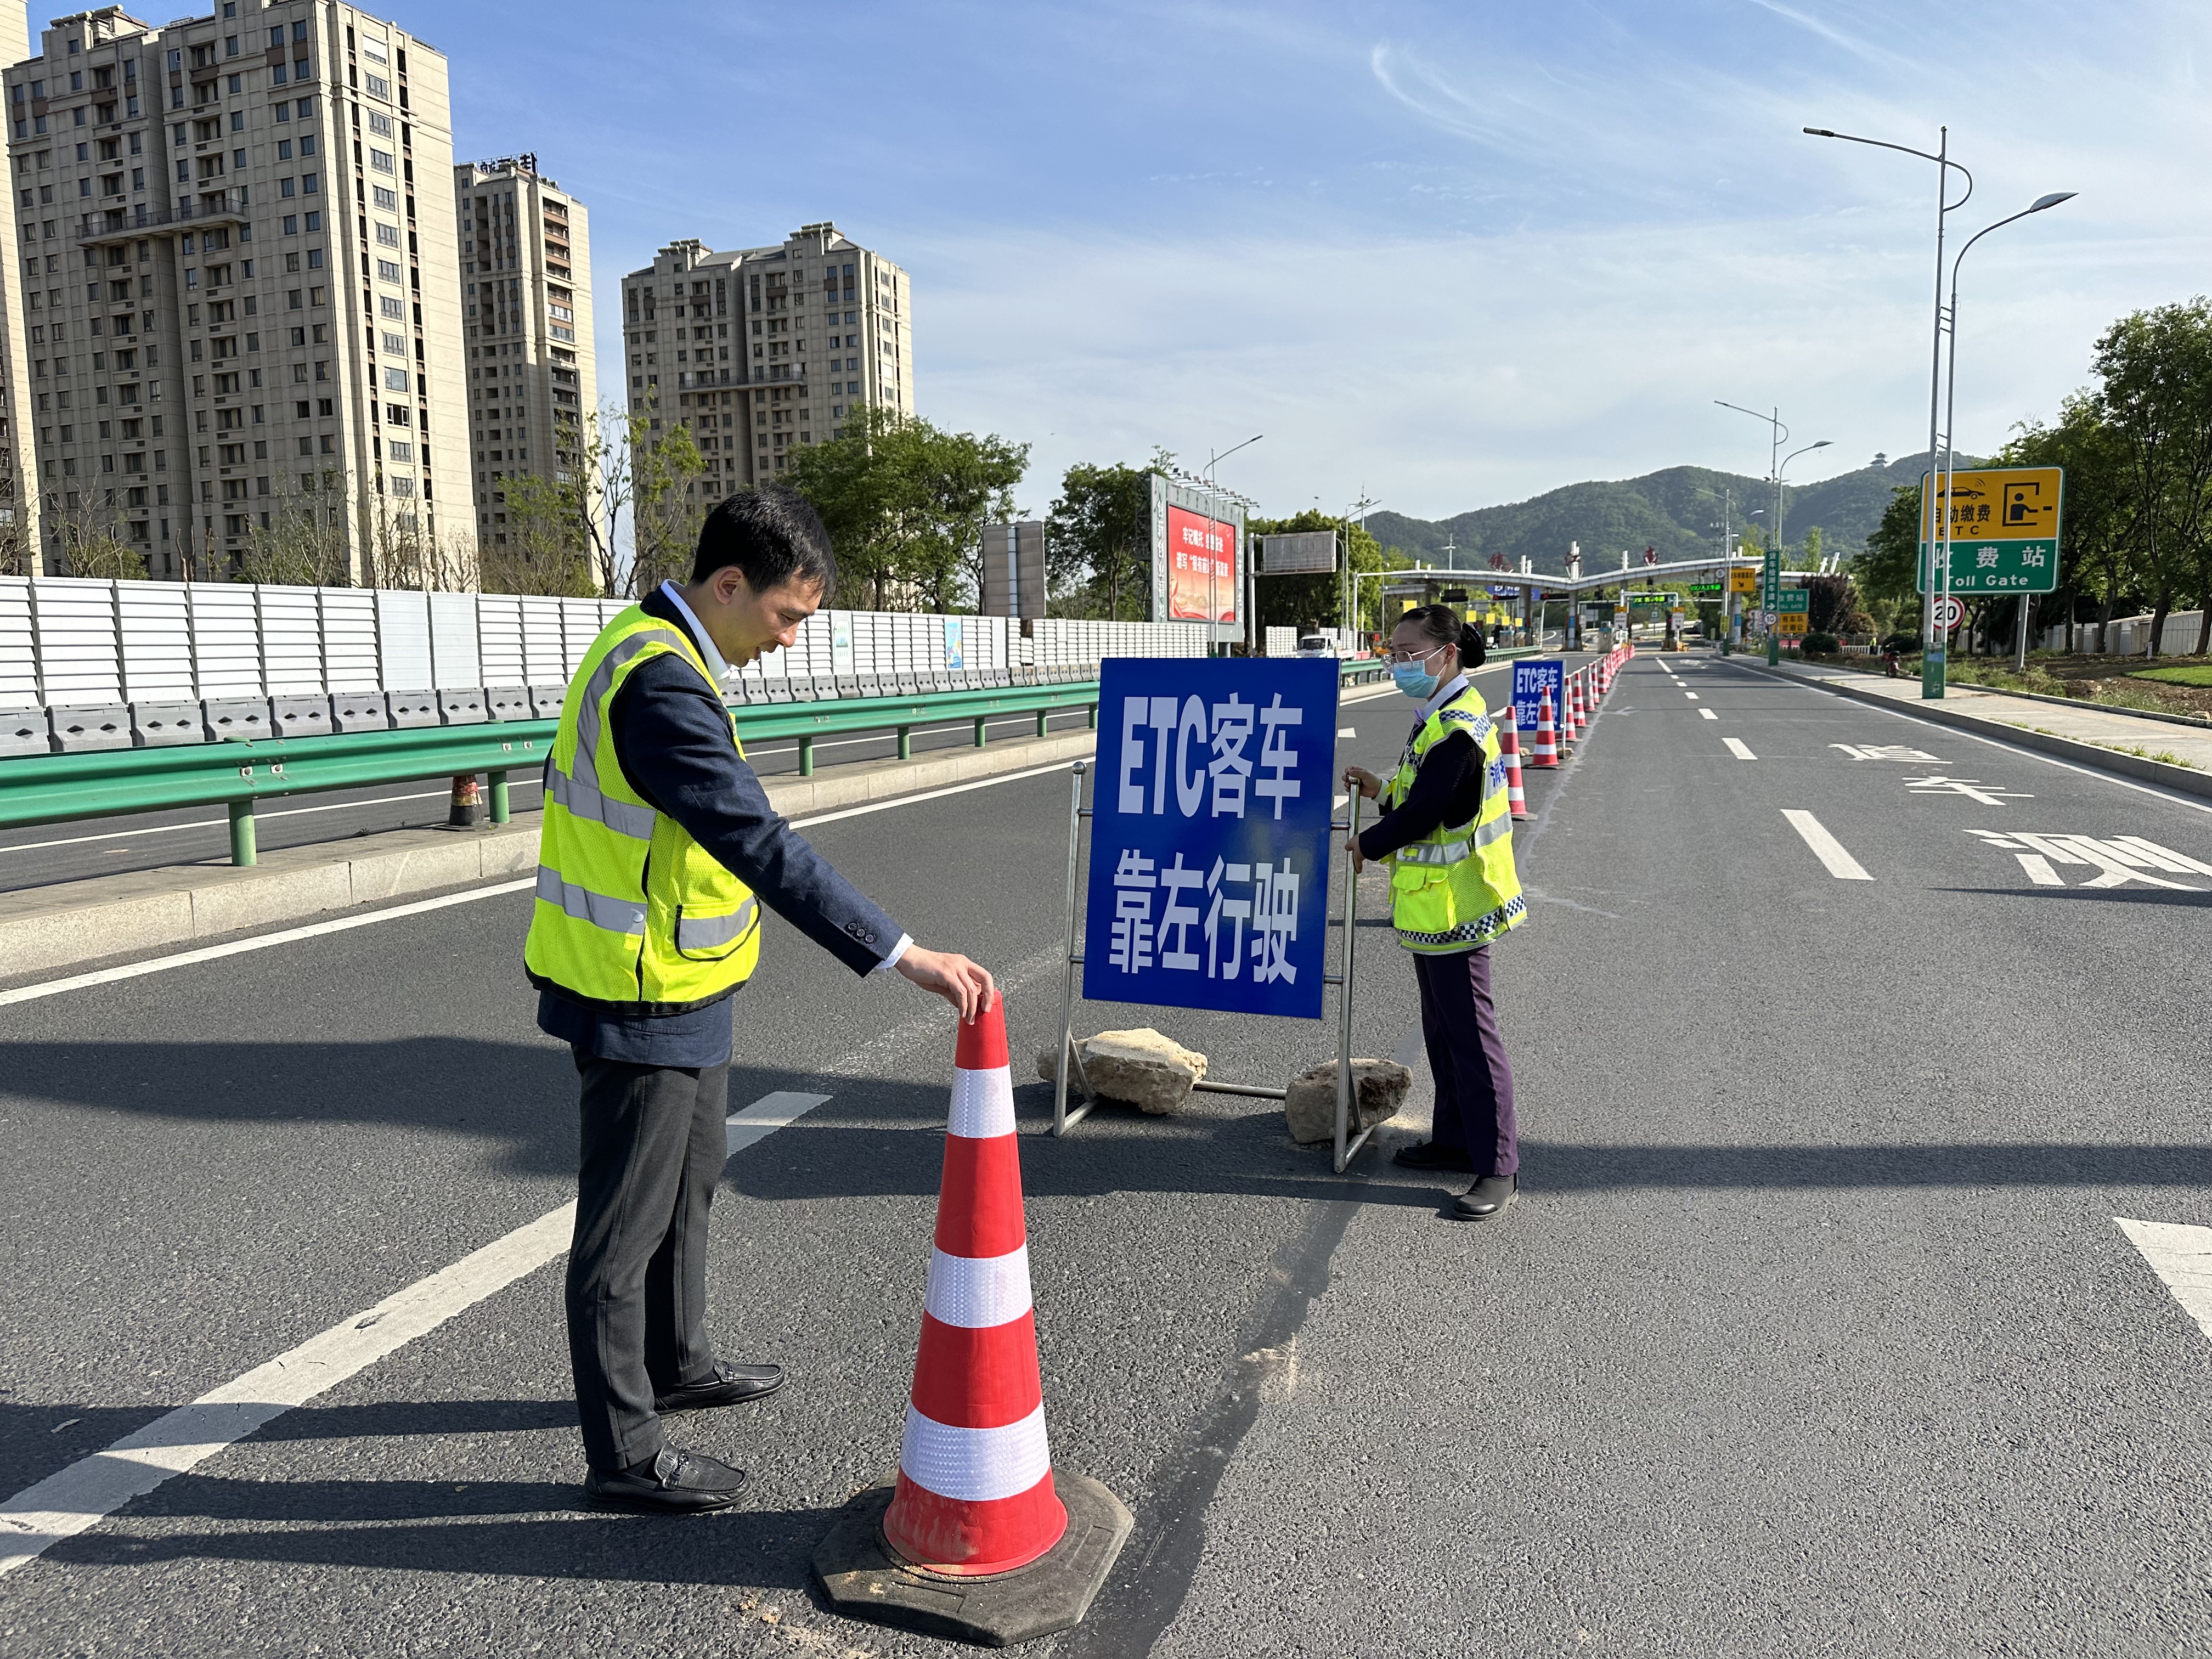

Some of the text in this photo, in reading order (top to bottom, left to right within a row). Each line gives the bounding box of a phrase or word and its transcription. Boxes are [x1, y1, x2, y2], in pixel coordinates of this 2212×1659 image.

[1935, 545, 2046, 569] 收费站
[1986, 574, 2028, 586] Gate
[1934, 606, 1957, 620] 20
[1516, 667, 1558, 693] ETC客车
[1118, 692, 1303, 820] ETC客车
[1109, 848, 1300, 985] 靠左行驶
